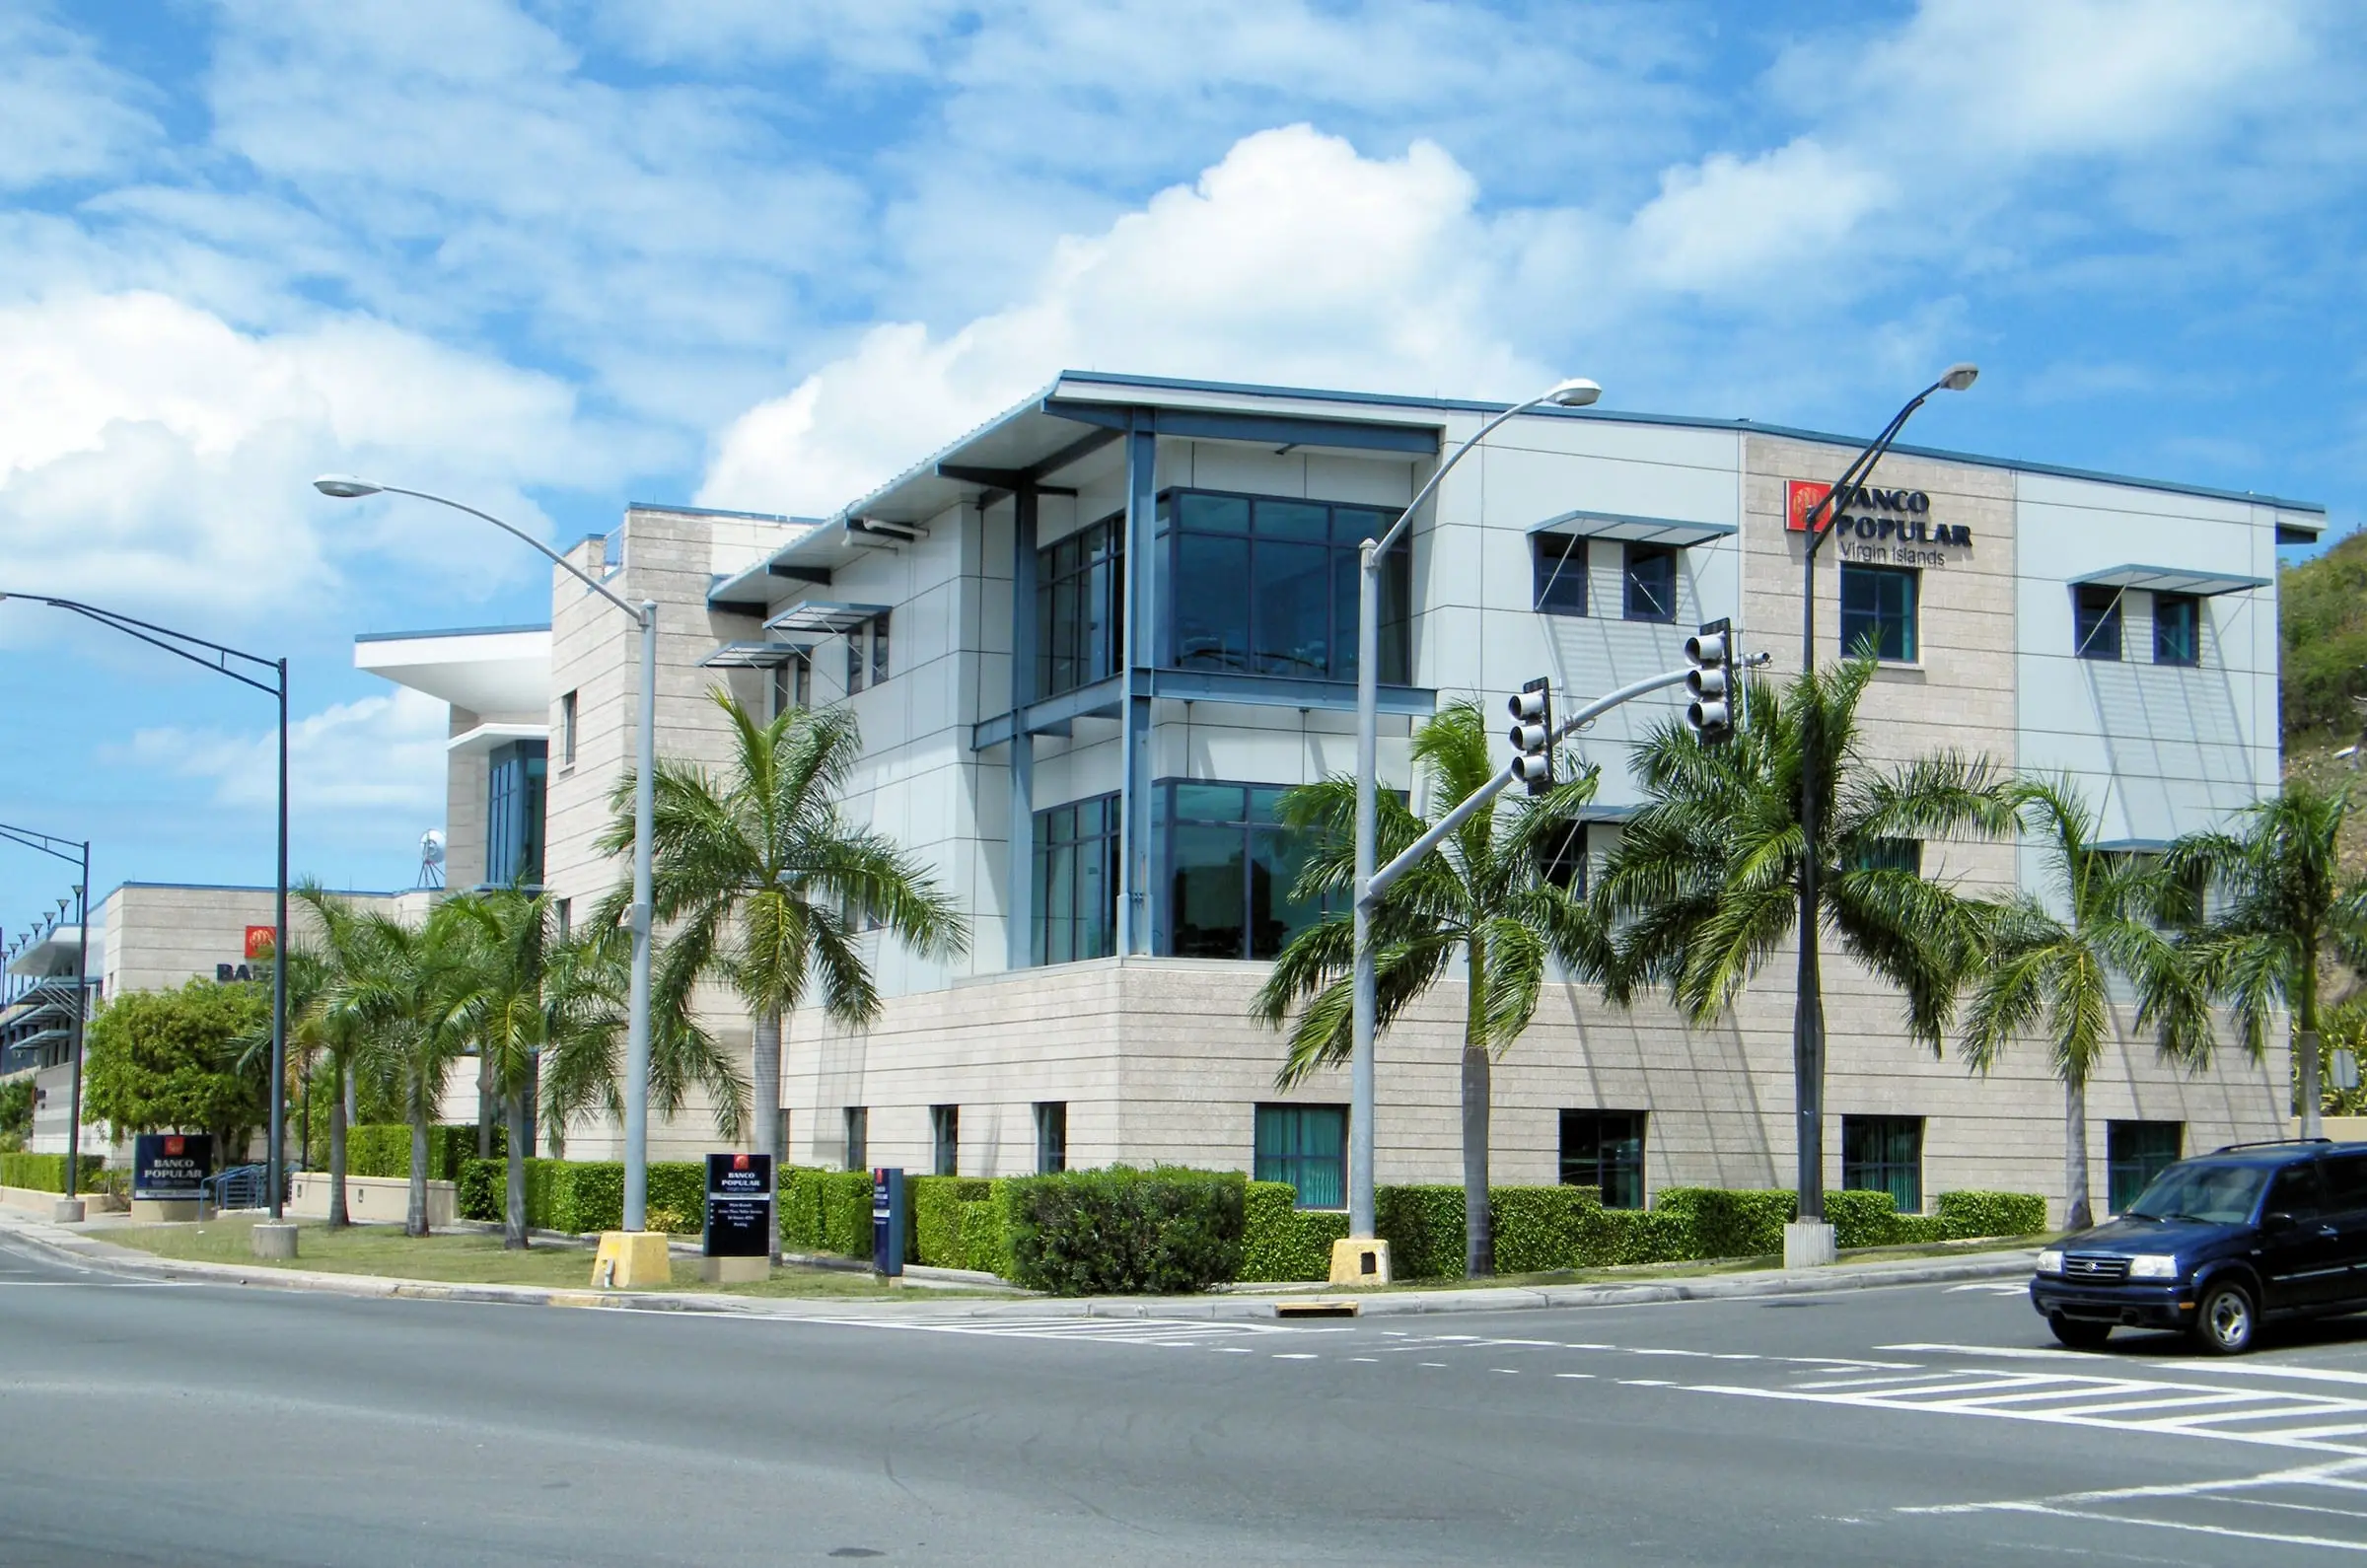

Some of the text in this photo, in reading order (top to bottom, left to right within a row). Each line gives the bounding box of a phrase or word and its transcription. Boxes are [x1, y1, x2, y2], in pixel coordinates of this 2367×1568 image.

[1836, 515, 1972, 547] POPULAR
[1840, 539, 1946, 566] Virgin Islands
[154, 1159, 195, 1169] BANCO
[143, 1169, 202, 1178] POPULAR
